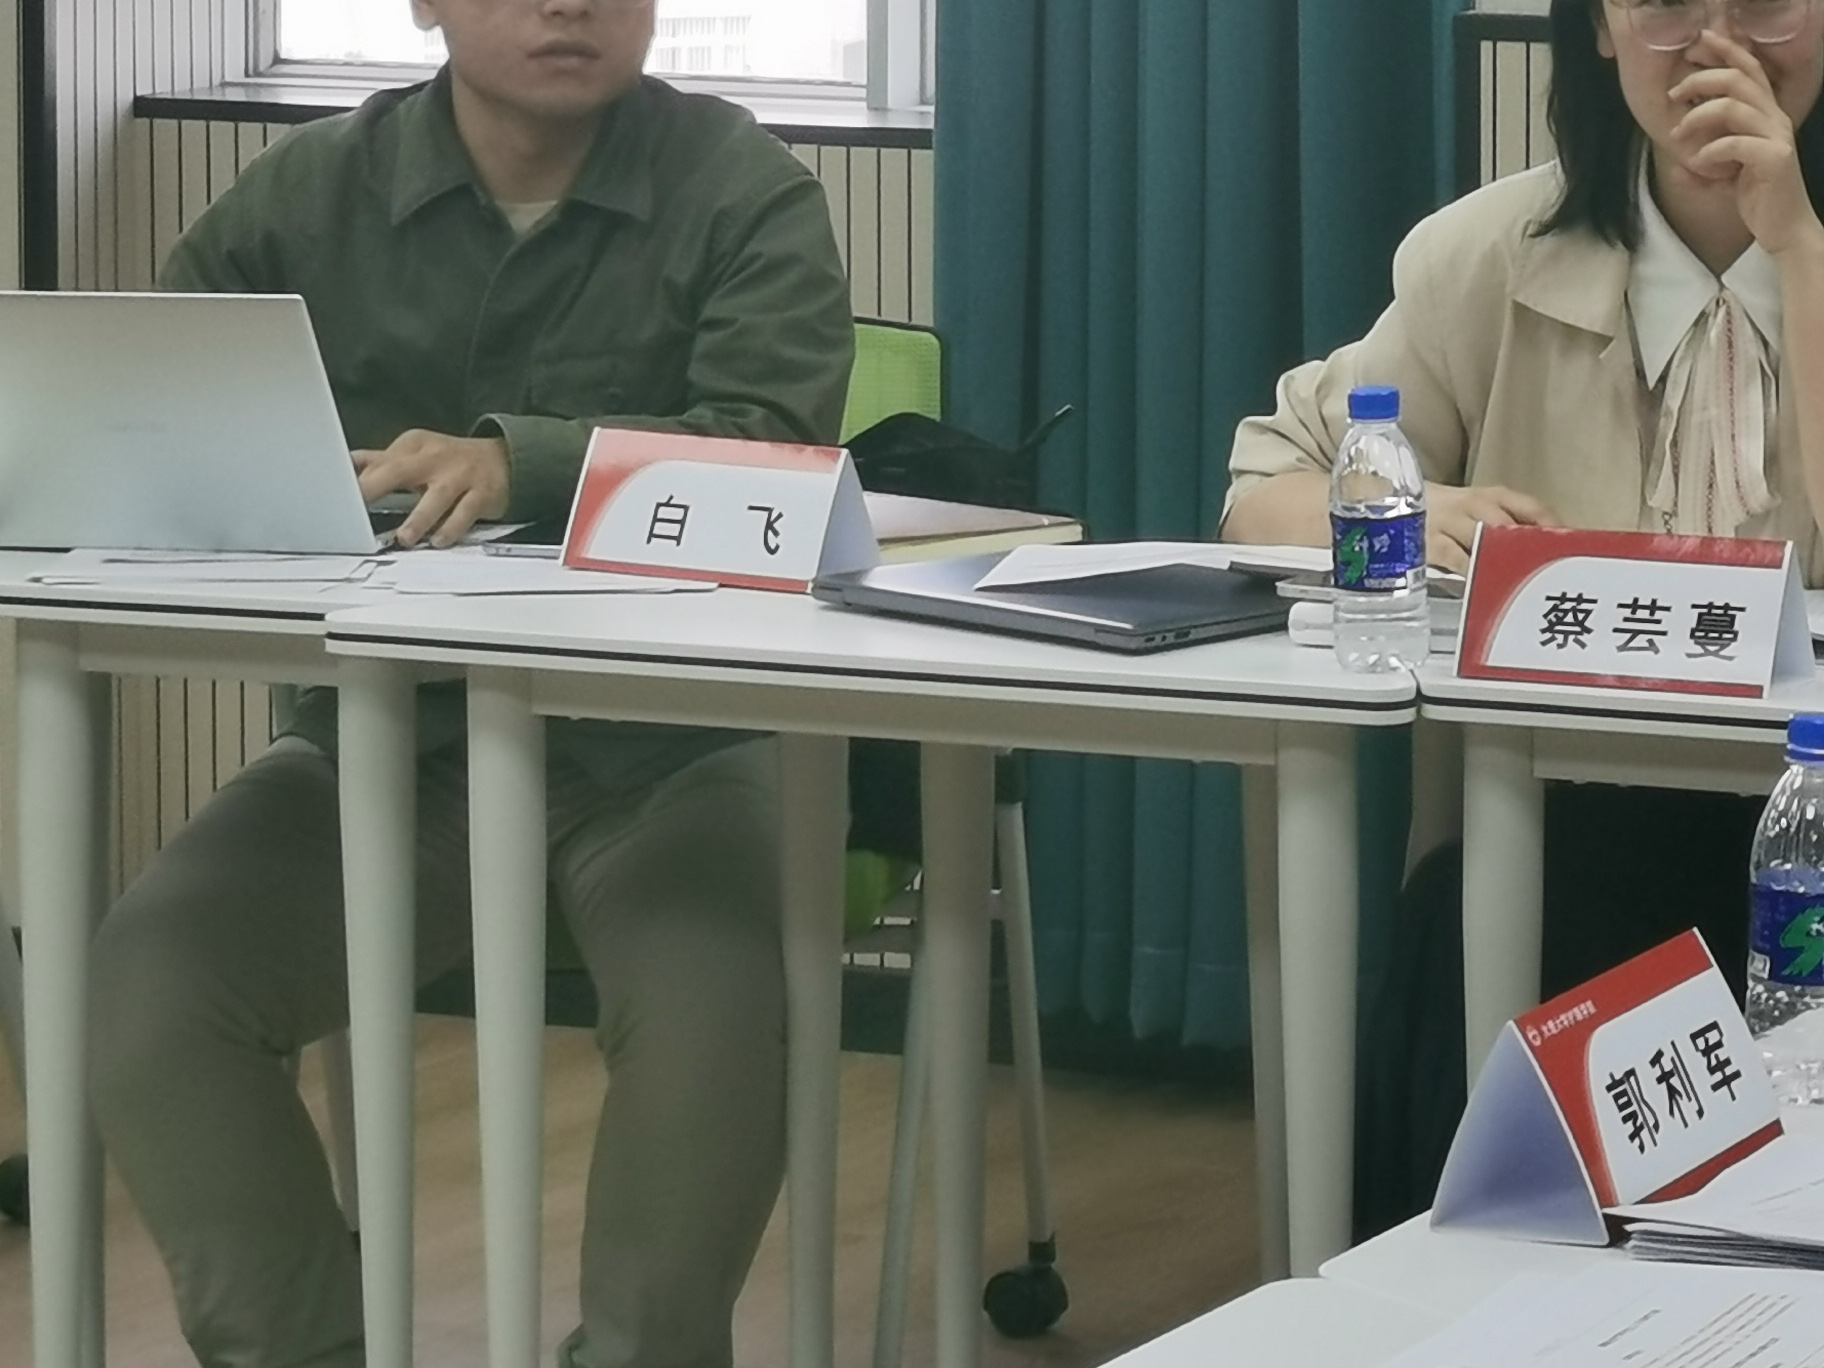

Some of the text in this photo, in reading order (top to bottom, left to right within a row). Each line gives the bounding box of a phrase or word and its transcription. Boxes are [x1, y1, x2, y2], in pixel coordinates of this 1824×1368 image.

[646, 494, 783, 556] 白飞
[1539, 591, 1748, 662] 蔡芸蔓
[1605, 1020, 1744, 1154] 郭利军
